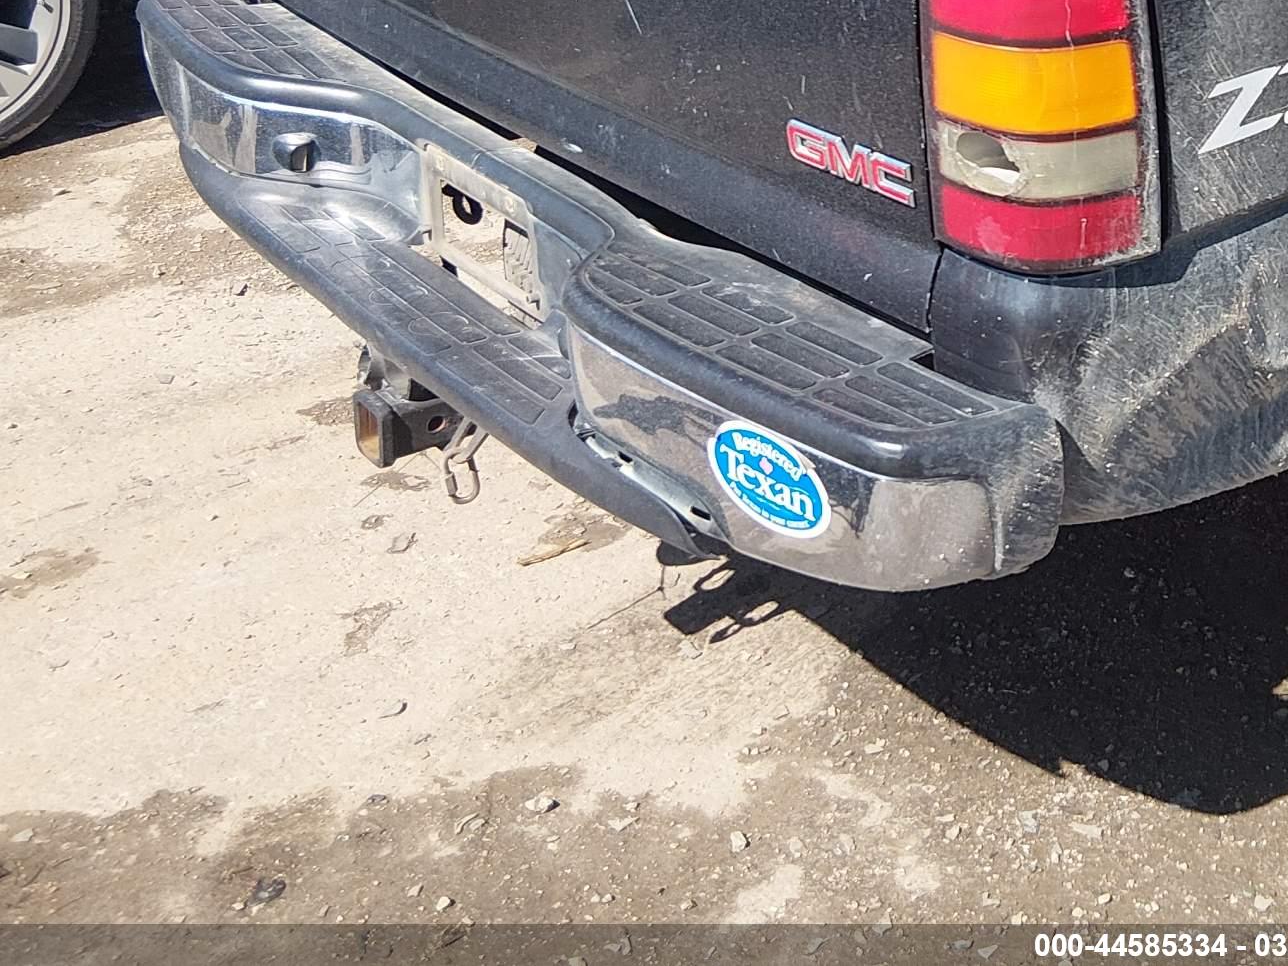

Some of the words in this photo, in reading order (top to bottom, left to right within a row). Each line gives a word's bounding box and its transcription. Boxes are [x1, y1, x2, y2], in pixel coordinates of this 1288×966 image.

[786, 118, 916, 208] GMC
[719, 443, 816, 522] Texan
[732, 432, 804, 482] Registered
